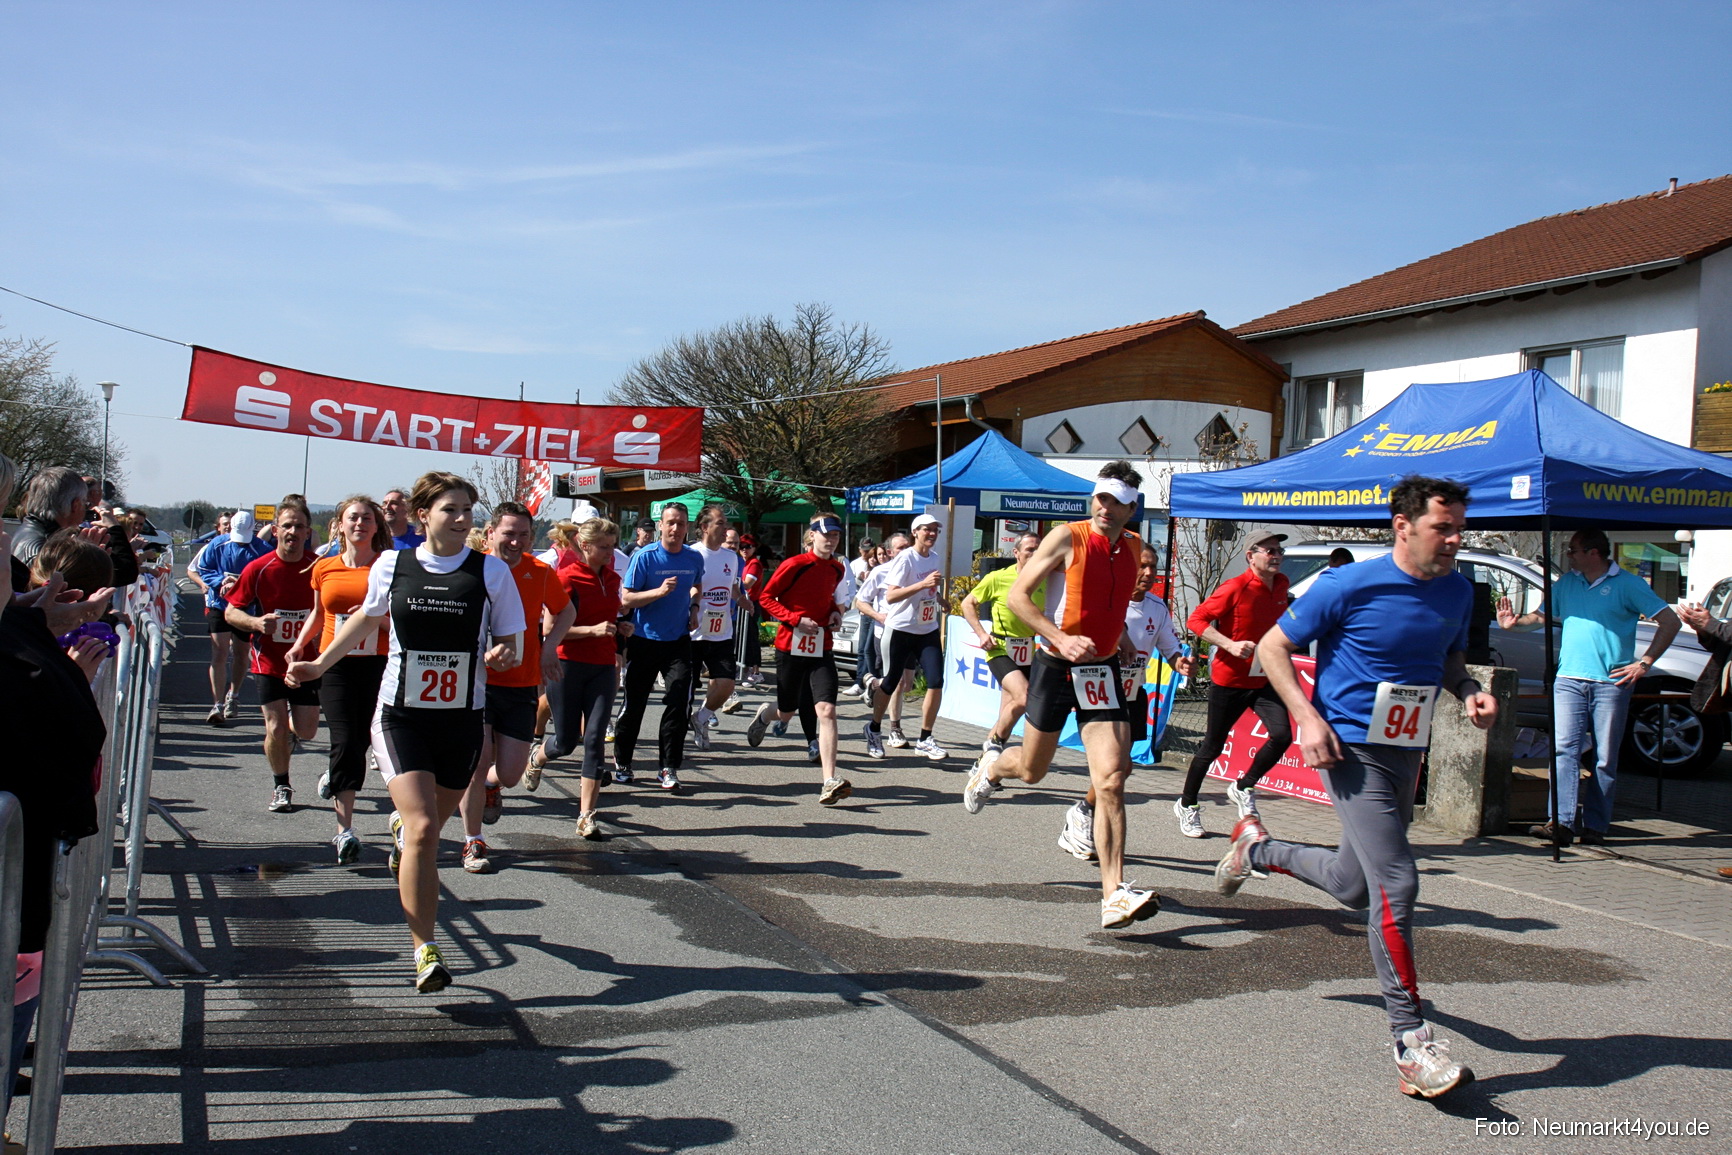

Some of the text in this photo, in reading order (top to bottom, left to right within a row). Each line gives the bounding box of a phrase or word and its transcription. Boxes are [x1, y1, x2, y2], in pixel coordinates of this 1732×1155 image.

[1373, 420, 1498, 452] EMMA
[578, 475, 597, 487] SEAT
[721, 502, 739, 516] OK
[1005, 497, 1083, 512] Neumarkter Tagblatt
[410, 604, 464, 615] Regensburg
[427, 598, 468, 607] Marathon
[922, 606, 934, 621] 92
[281, 620, 306, 640] 98
[709, 618, 723, 633] 18
[797, 635, 816, 654] 45
[417, 654, 447, 662] MEYER
[1012, 646, 1028, 663] 70
[420, 669, 458, 703] 28
[1084, 680, 1109, 706] 64
[1390, 688, 1418, 696] MEYER
[1384, 704, 1421, 740] 94
